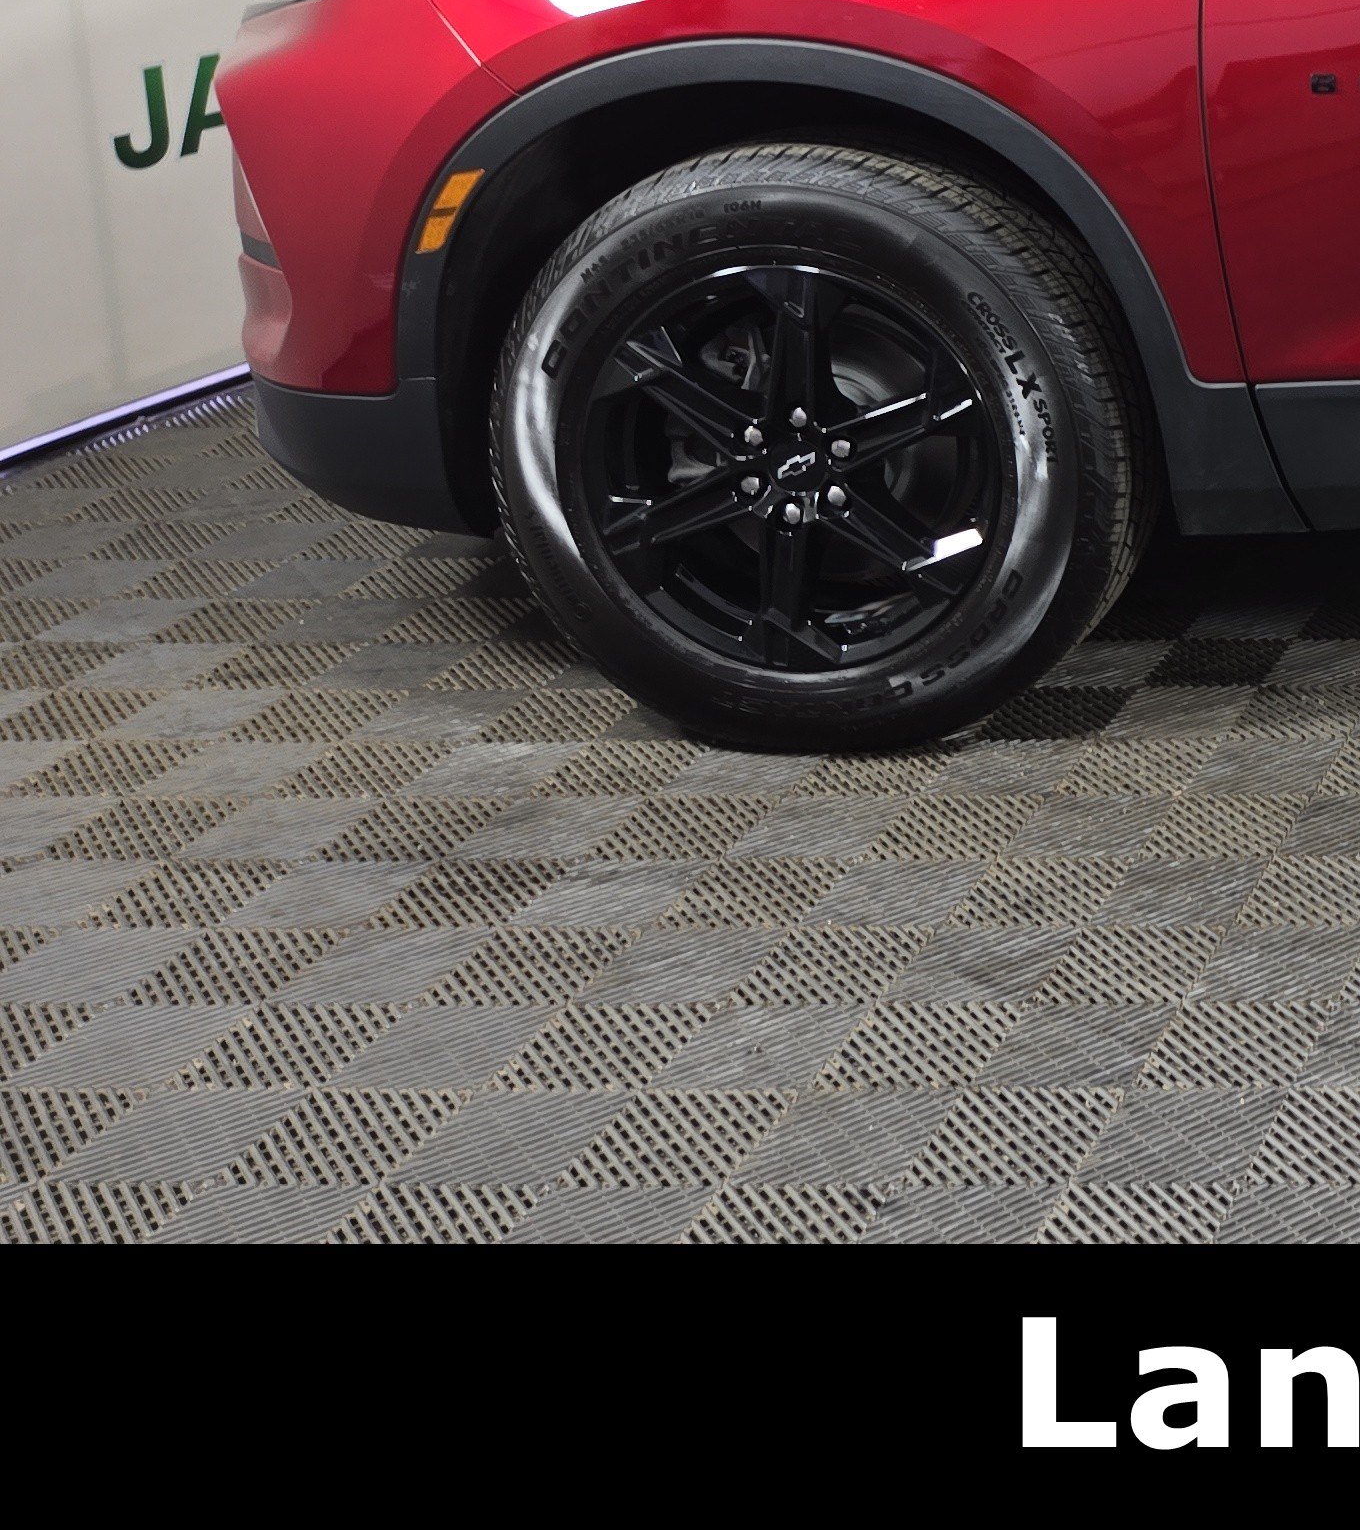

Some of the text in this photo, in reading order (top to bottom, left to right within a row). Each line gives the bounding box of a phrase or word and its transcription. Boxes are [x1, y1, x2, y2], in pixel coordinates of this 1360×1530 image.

[113, 52, 226, 170] JA
[967, 291, 1018, 352] CROSS
[1005, 349, 1042, 400] LX
